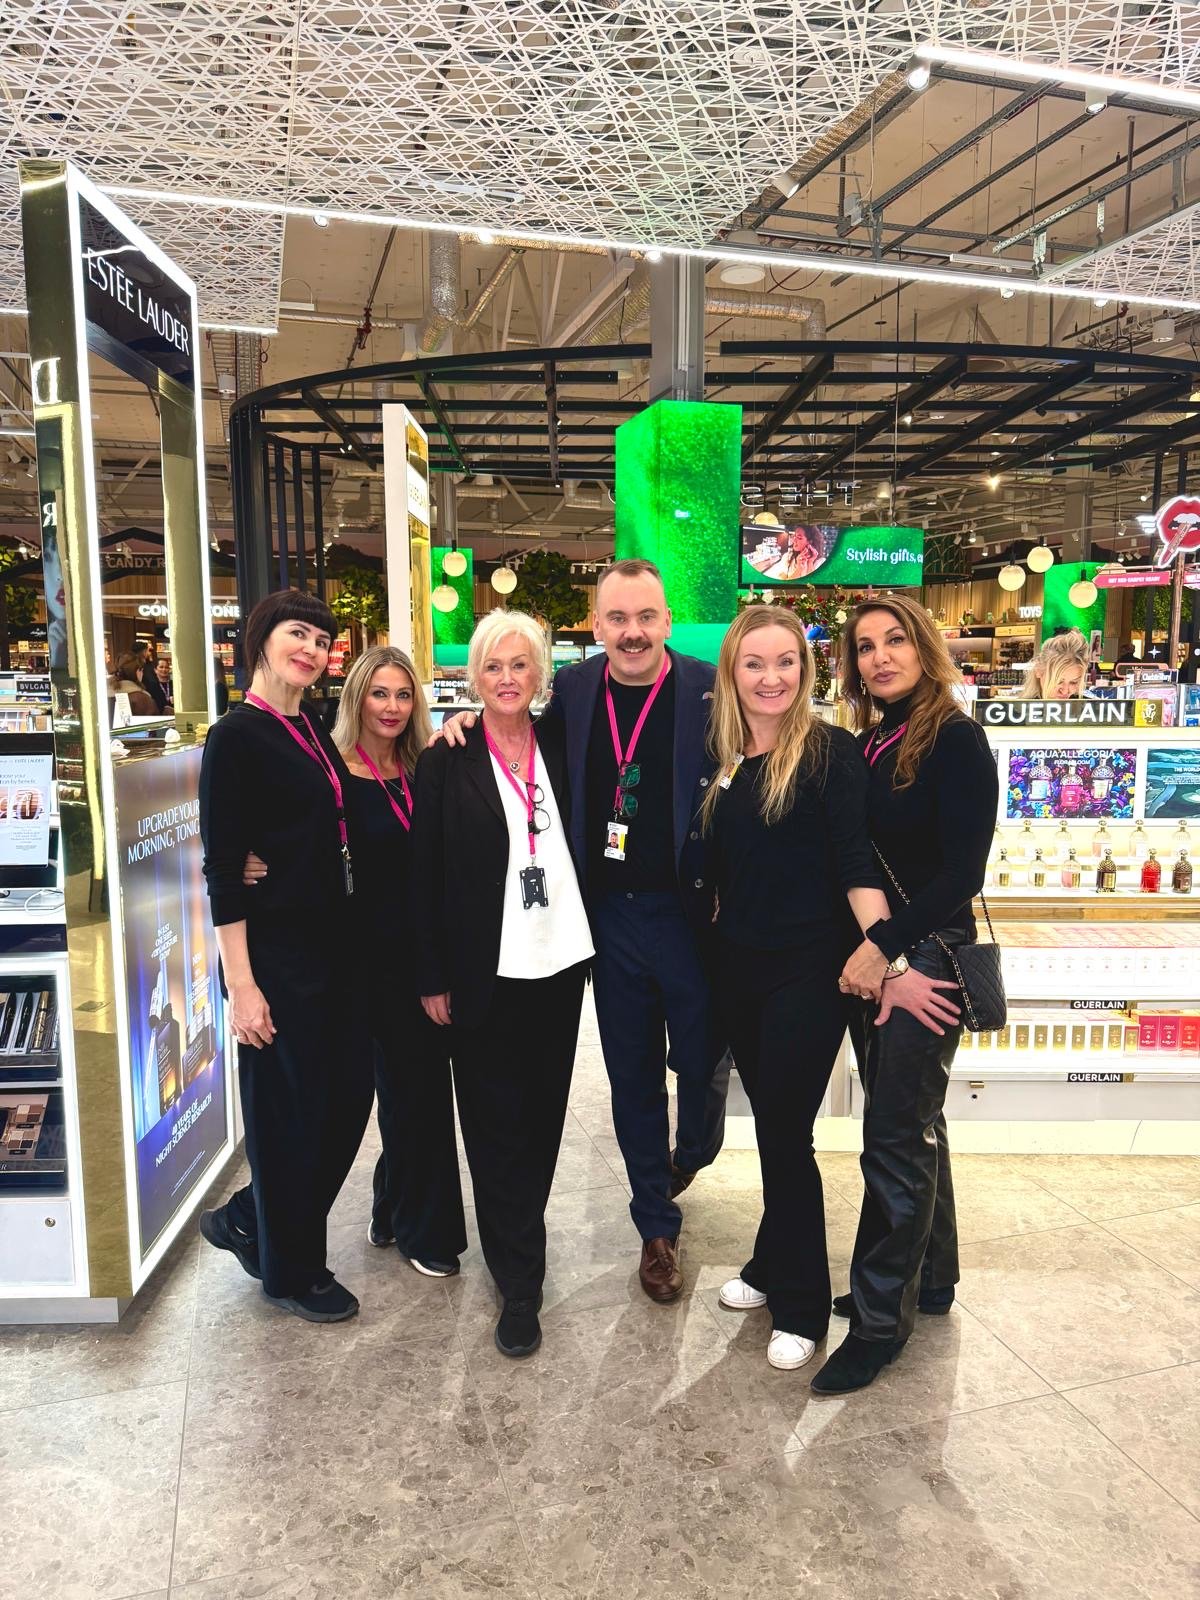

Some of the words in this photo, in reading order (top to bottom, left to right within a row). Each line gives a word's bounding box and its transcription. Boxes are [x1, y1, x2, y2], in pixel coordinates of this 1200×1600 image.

[138, 288, 190, 356] LAUDER
[106, 557, 151, 569] CANDY
[846, 548, 888, 565] Stylish
[890, 549, 917, 565] gifts,
[1019, 605, 1043, 618] TOYS
[433, 680, 468, 688] VENCHY
[985, 702, 1126, 723] GUERLAIN
[1030, 750, 1058, 759] AQUA
[1060, 750, 1115, 759] ALLEGORIA
[138, 806, 179, 837] UPGRADE
[179, 799, 200, 821] YOUR
[128, 829, 176, 864] MORNING,
[175, 818, 200, 842] TONIG
[1073, 1001, 1125, 1009] GUERLAIN
[1069, 1073, 1121, 1082] GUERLAIN
[177, 1106, 192, 1129] YEARS
[155, 1140, 172, 1168] NIGHT
[172, 1119, 191, 1148] SCIENCE
